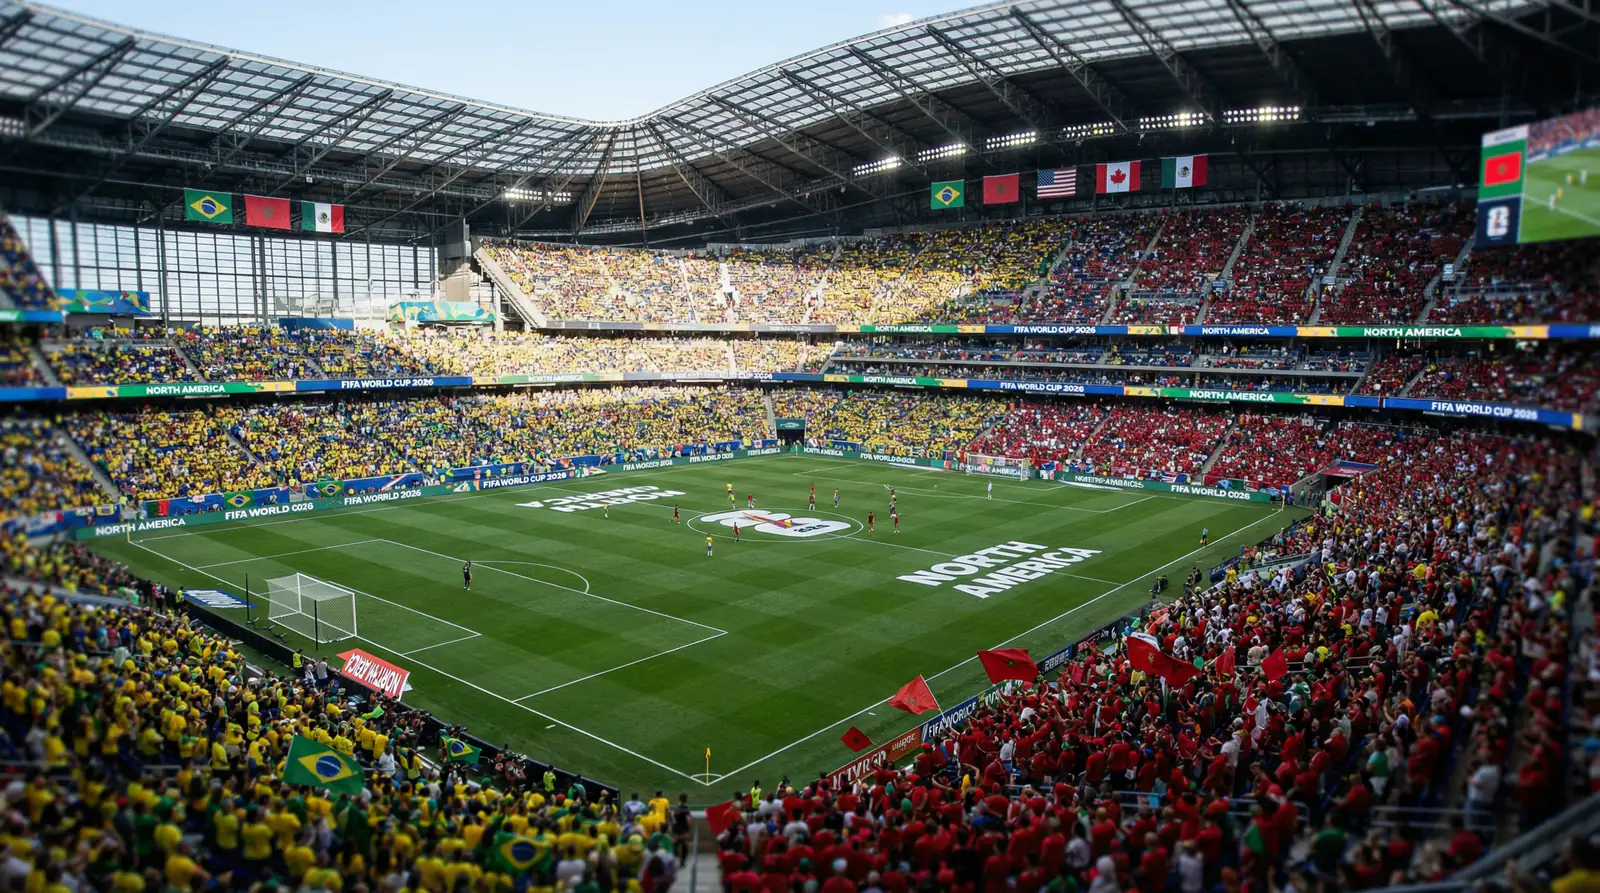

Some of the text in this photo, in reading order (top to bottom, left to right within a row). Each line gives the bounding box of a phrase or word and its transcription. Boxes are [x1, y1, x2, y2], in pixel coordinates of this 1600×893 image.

[1014, 326, 1096, 334] FIFA WORLD CUP 2026
[1202, 327, 1270, 335] NORTH AMERICA
[1364, 328, 1462, 337] NORTH AMERICA
[146, 384, 226, 395] NORTH AMERICA
[341, 378, 434, 389] FIFA WORLD CUP 2026
[1016, 382, 1046, 390] WORLD
[1190, 390, 1274, 402] NORTH AMERICA
[1431, 401, 1538, 420] FIFA WORLD CUP 2026
[483, 480, 500, 489] FIFA
[501, 476, 530, 486] WORLD
[530, 474, 546, 482] CUP
[1170, 484, 1190, 494] FIFA
[1191, 486, 1227, 498] WORLD
[344, 496, 362, 506] FIFA
[225, 510, 248, 520] FIFA
[248, 504, 290, 517] WORLD
[95, 518, 186, 536] NORTH AMERICA
[896, 540, 1049, 586] NORTH
[952, 547, 1103, 599] AMERICA
